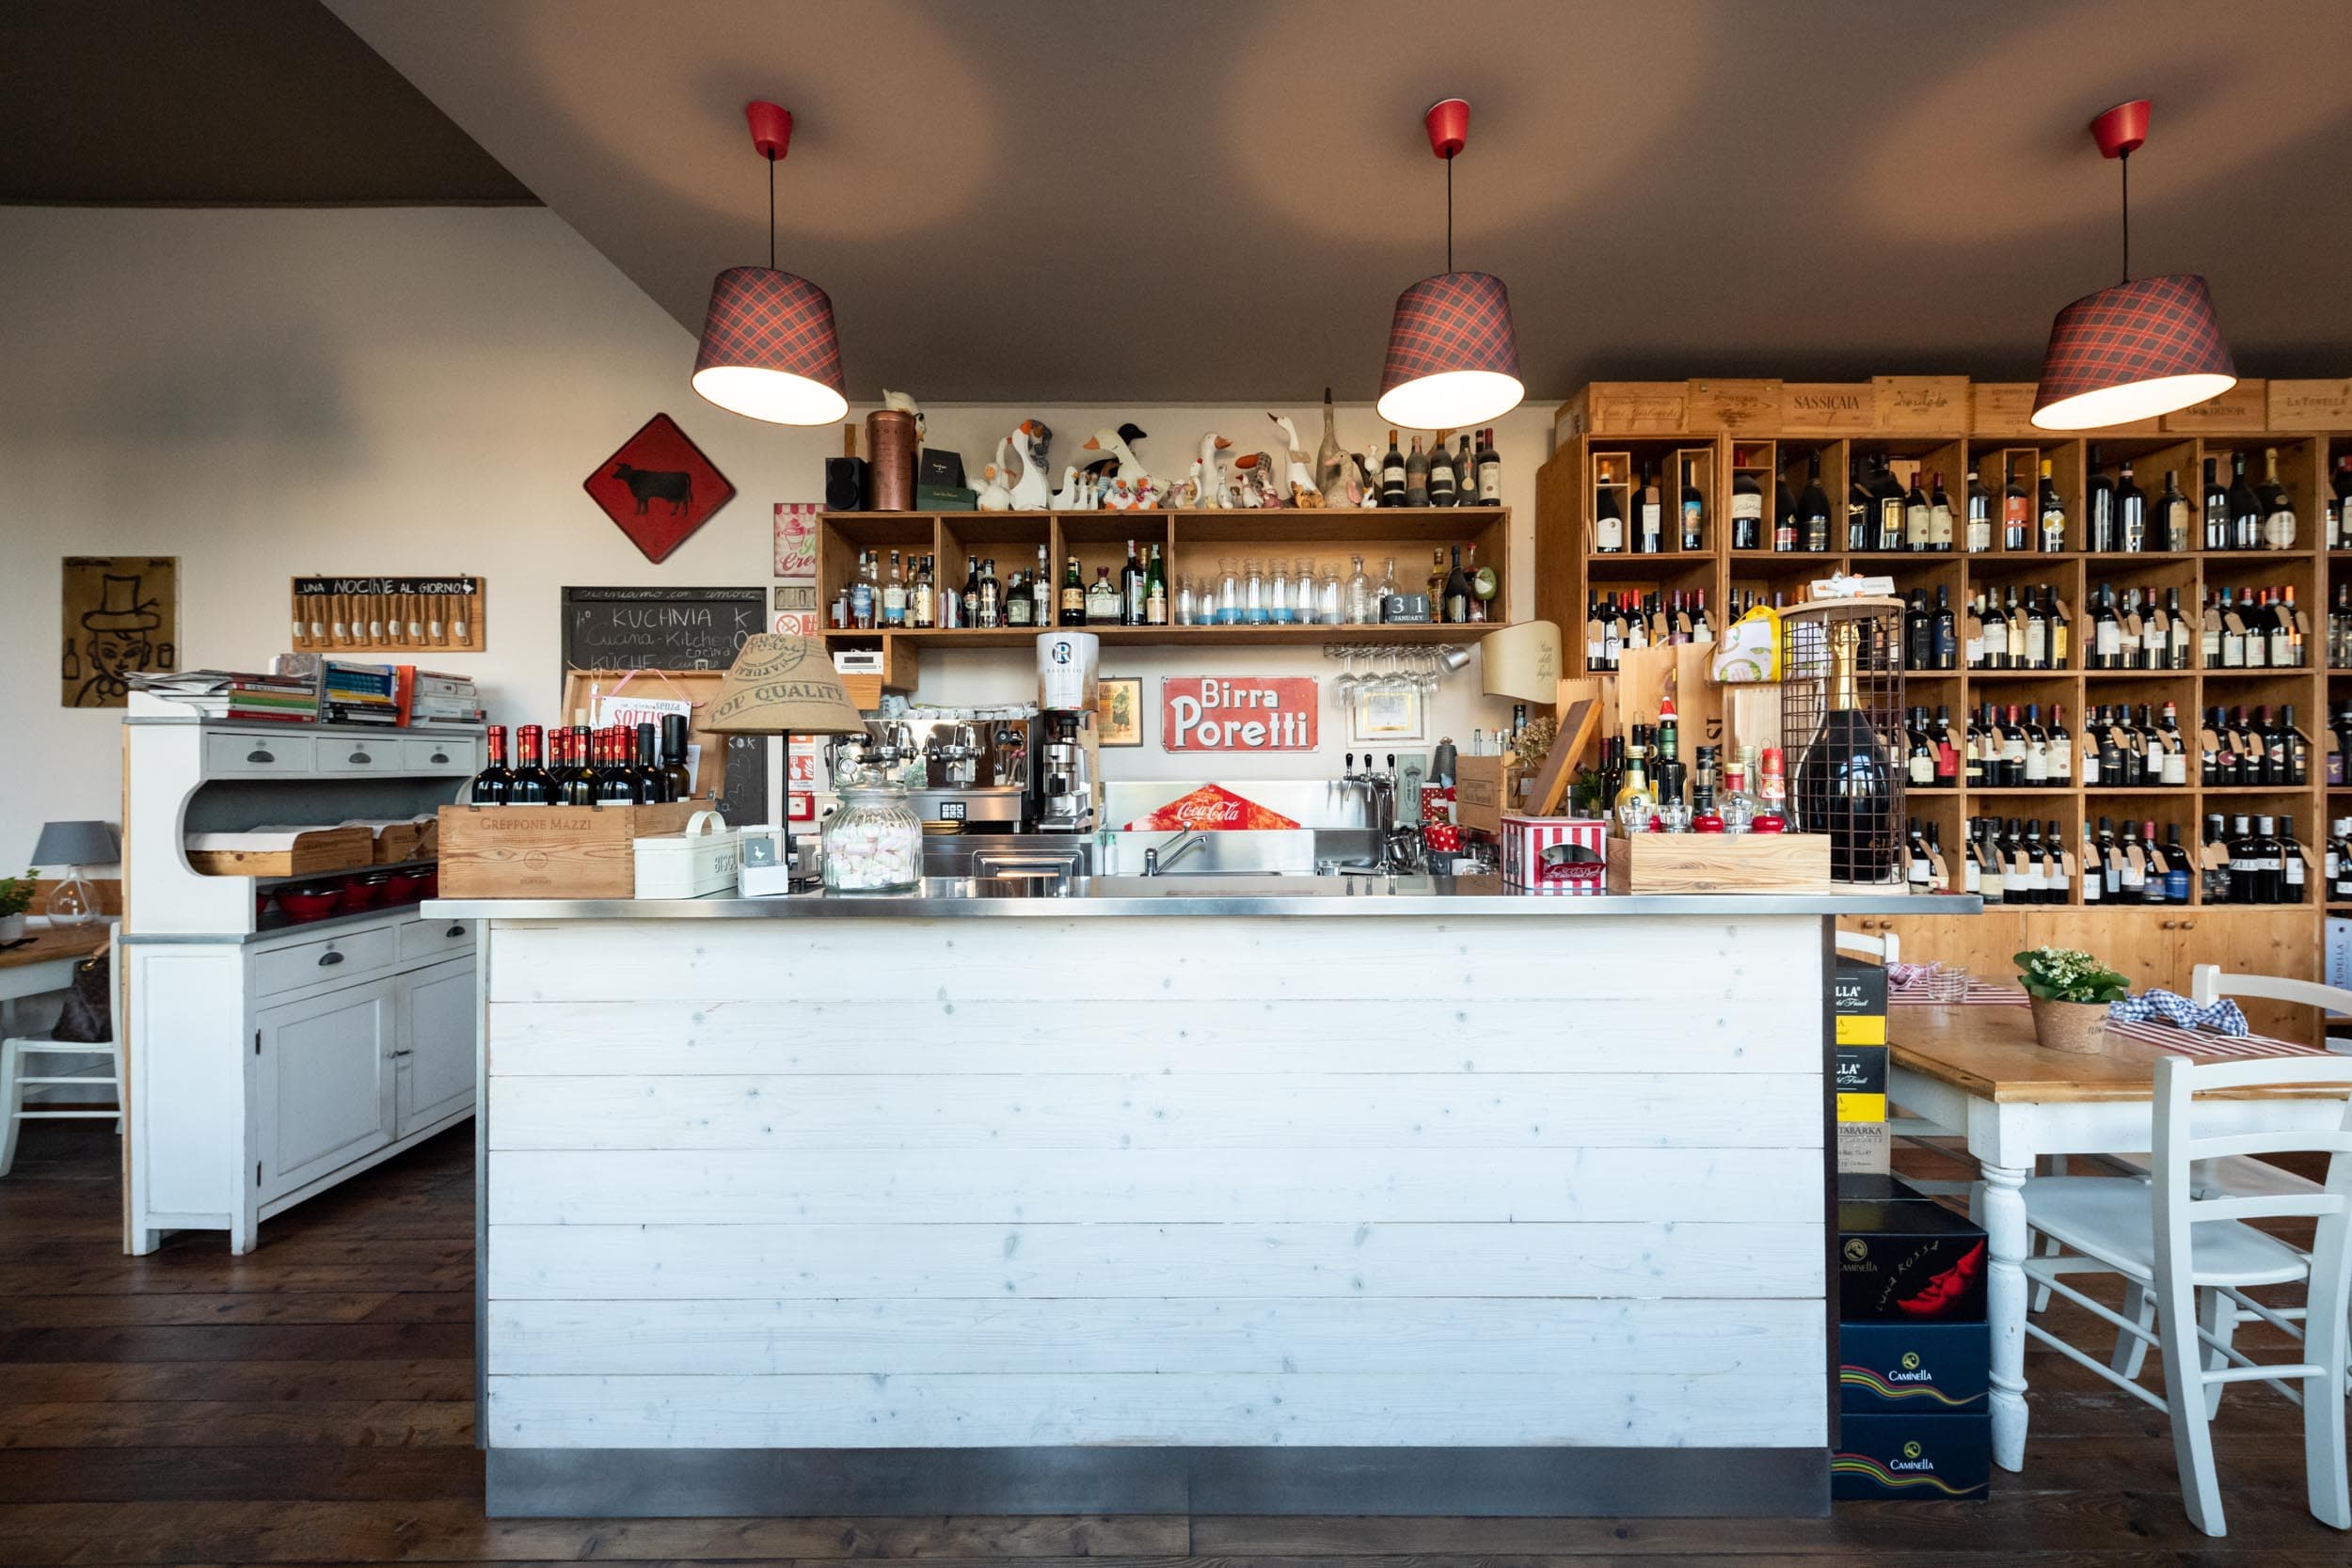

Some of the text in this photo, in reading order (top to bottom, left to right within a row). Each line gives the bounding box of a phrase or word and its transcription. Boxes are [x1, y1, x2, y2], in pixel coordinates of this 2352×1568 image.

[1794, 395, 1860, 410] SASSICAIA
[400, 583, 414, 594] AL
[612, 608, 712, 628] KUCHNIA
[665, 630, 733, 648] Kitchen
[1201, 678, 1279, 708] Birra
[710, 683, 844, 723] TOP QUALITY
[1169, 695, 1309, 748] Poretti
[481, 817, 592, 832] GREPPONE MAZZI
